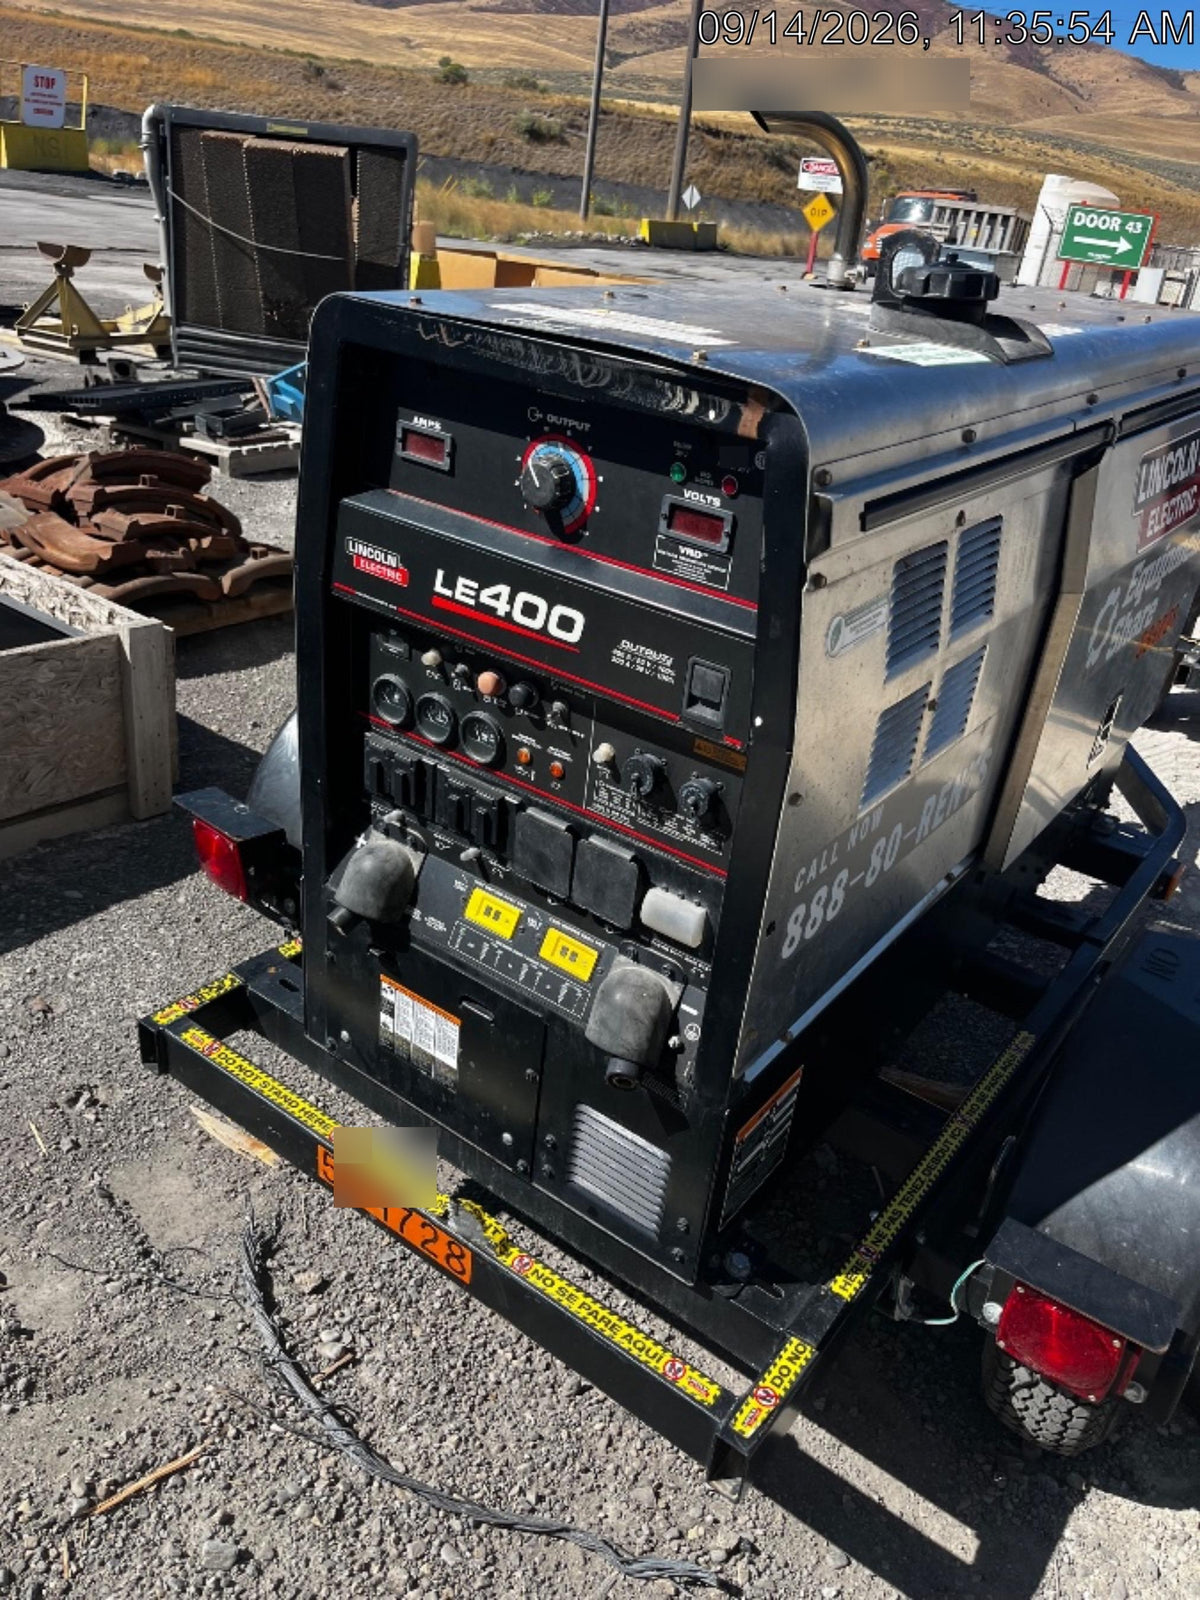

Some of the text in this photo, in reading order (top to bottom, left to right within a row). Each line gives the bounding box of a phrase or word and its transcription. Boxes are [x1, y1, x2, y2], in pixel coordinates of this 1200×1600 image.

[34, 75, 56, 89] STOP
[1073, 211, 1143, 234] DOOR 43
[412, 415, 442, 431] AMPS
[546, 413, 591, 432] OUTPUT
[1137, 438, 1200, 504] LINCOLN
[683, 489, 721, 507] VOLTS
[1147, 484, 1198, 539] ELECTRIC
[349, 541, 398, 568] LINCOLN
[360, 557, 402, 583] ELECTRIC
[432, 567, 586, 644] LE400
[794, 804, 885, 894] CALL NOW
[217, 1051, 334, 1132] DO NOT STAND HERE
[872, 1230, 887, 1247] NE
[883, 1208, 903, 1231] PAS
[898, 1175, 926, 1209] TENEZ
[922, 1139, 955, 1177] DEBOUT
[531, 1268, 556, 1288] NO
[556, 1285, 578, 1304] SE
[578, 1301, 623, 1336] PARE
[771, 1364, 791, 1389] DO
